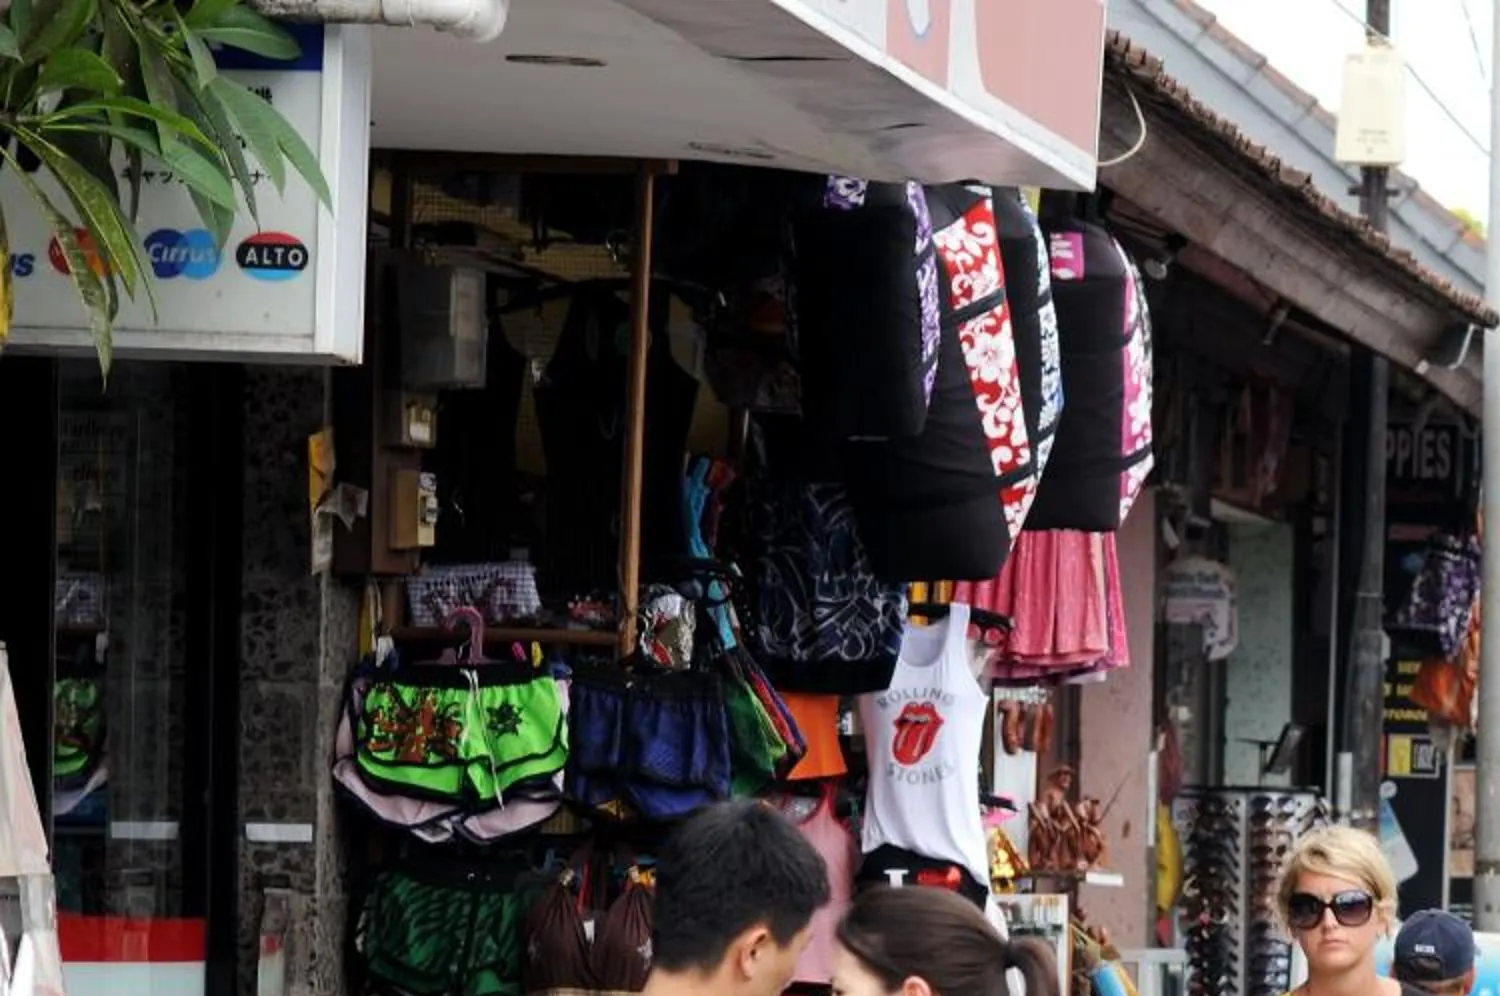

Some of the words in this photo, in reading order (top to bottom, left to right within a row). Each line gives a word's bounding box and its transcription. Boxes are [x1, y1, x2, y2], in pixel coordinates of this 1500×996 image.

[150, 243, 217, 264] Cirrus
[245, 246, 303, 266] ALTO
[877, 687, 956, 710] ROLLING
